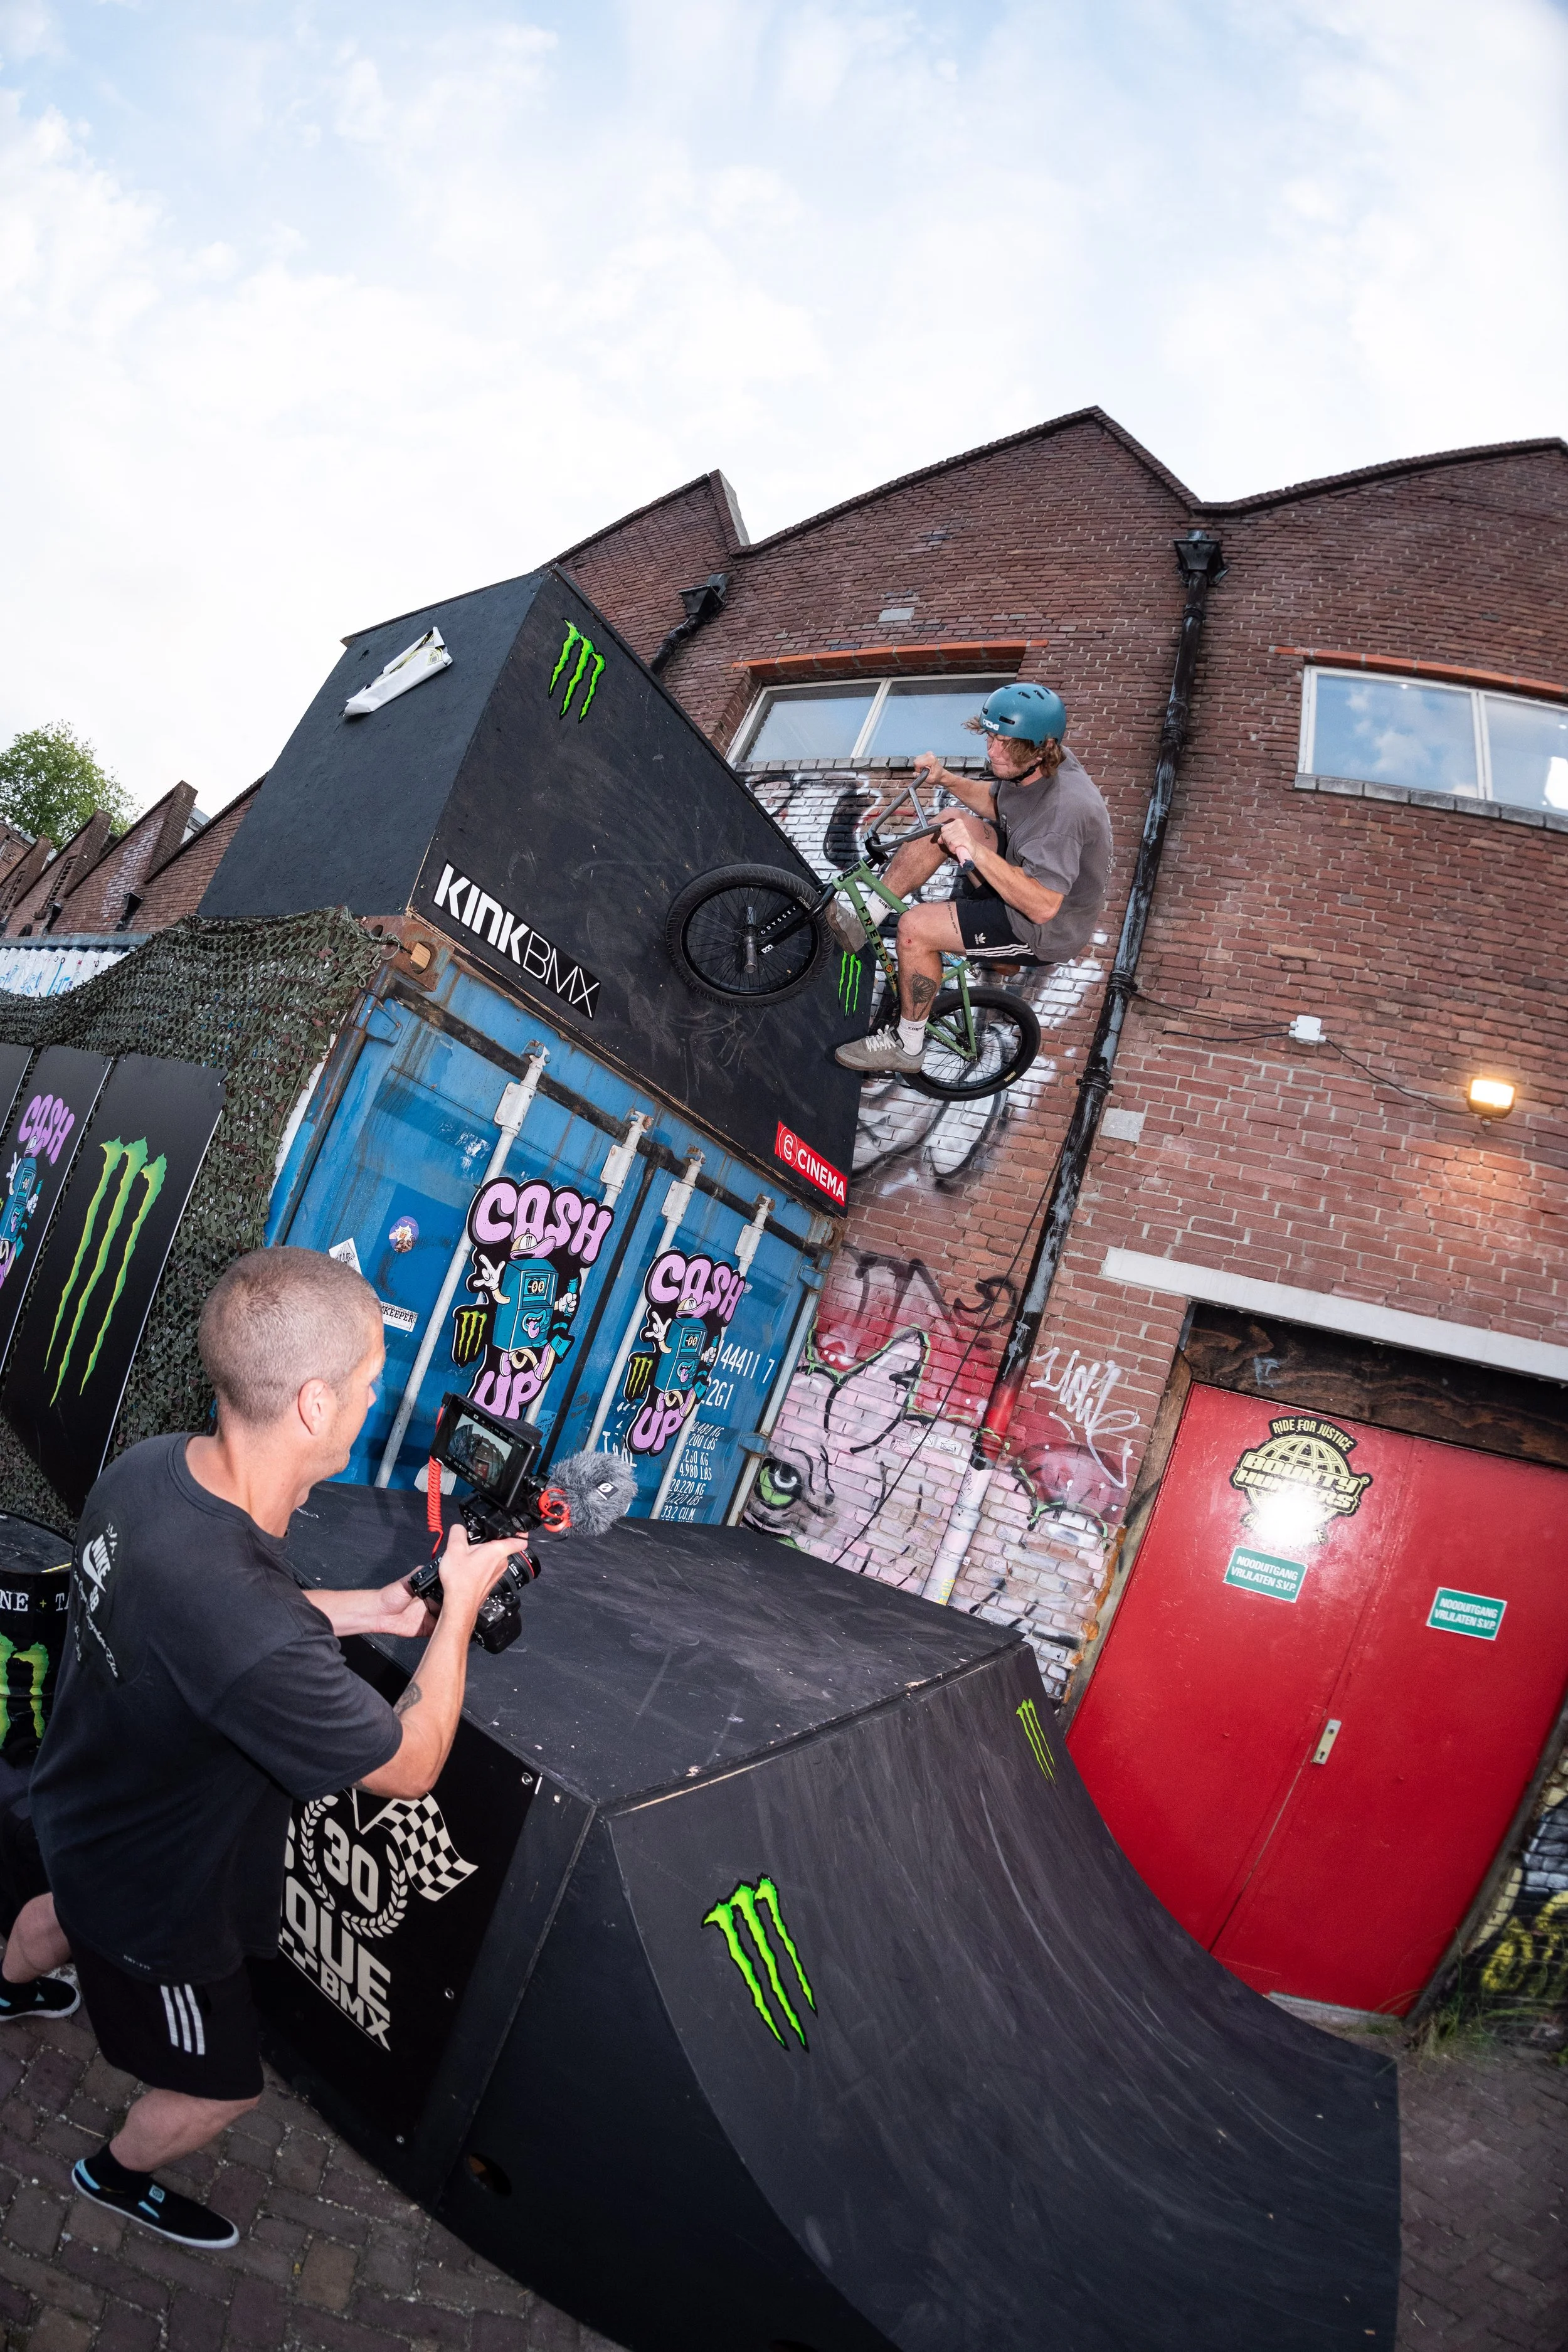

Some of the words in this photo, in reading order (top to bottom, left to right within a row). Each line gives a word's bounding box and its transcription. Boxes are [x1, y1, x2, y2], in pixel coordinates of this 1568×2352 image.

[522, 931, 600, 1018] BMX
[18, 1094, 75, 1165] CASH
[797, 1148, 845, 1202] CINEMA
[474, 1182, 613, 1263] CASH
[649, 1254, 746, 1323] CASH
[473, 1370, 544, 1420] UP
[632, 1406, 687, 1451] UP
[703, 1436, 718, 1451] LBS
[1272, 1419, 1295, 1434] RIDE
[1297, 1419, 1316, 1433] FOR
[1317, 1424, 1353, 1451] JUSTICE
[694, 1482, 706, 1496] KG
[700, 1466, 712, 1480] LBS
[1242, 1454, 1359, 1493] BOUNTY
[661, 1505, 679, 1518] 33.2
[686, 1495, 703, 1506] LBS
[92, 1534, 111, 1577] NIKE
[1231, 1566, 1276, 1586] VRIJLATEN
[1236, 1555, 1298, 1581] NOODUITGANG
[90, 1585, 99, 1612] SB
[1439, 1598, 1498, 1619] NOODUITGANG
[324, 1818, 379, 1913] 30
[281, 1876, 391, 2023] QUE
[320, 1959, 391, 2052] BMX
